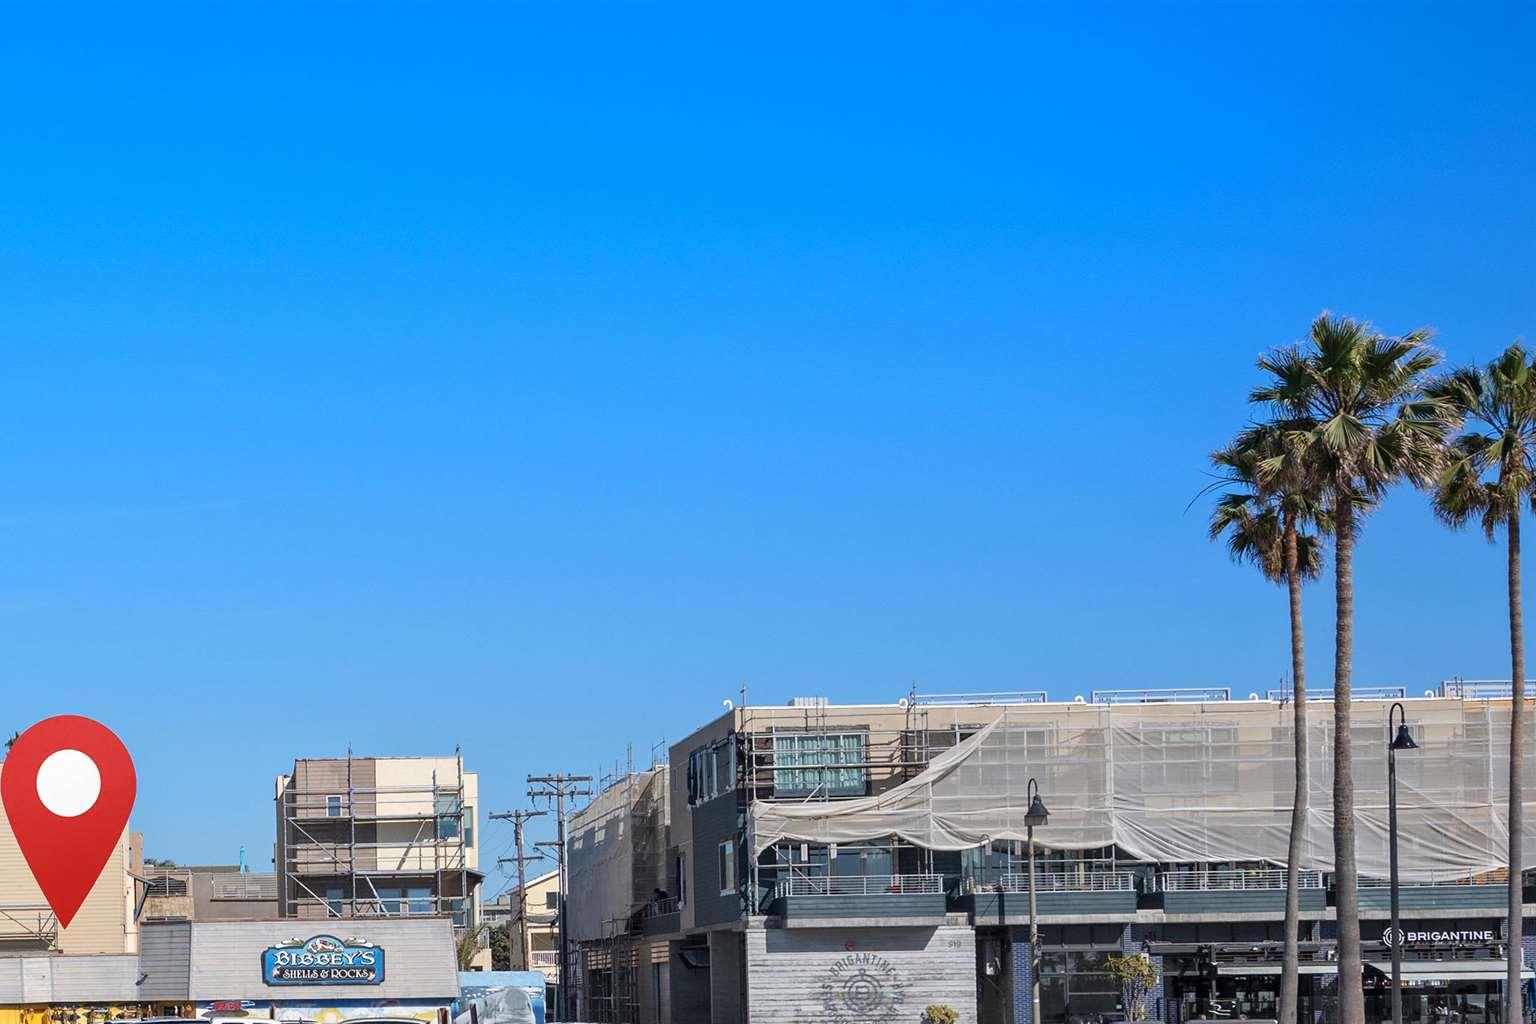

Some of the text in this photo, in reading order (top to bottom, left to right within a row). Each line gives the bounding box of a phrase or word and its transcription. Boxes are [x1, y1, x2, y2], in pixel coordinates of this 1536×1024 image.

[1407, 931, 1494, 941] BRIGANTINE
[273, 950, 376, 966] BIBBEY'S
[828, 953, 896, 977] BRIGANTINE
[283, 968, 369, 979] SHELLS & ROCKS
